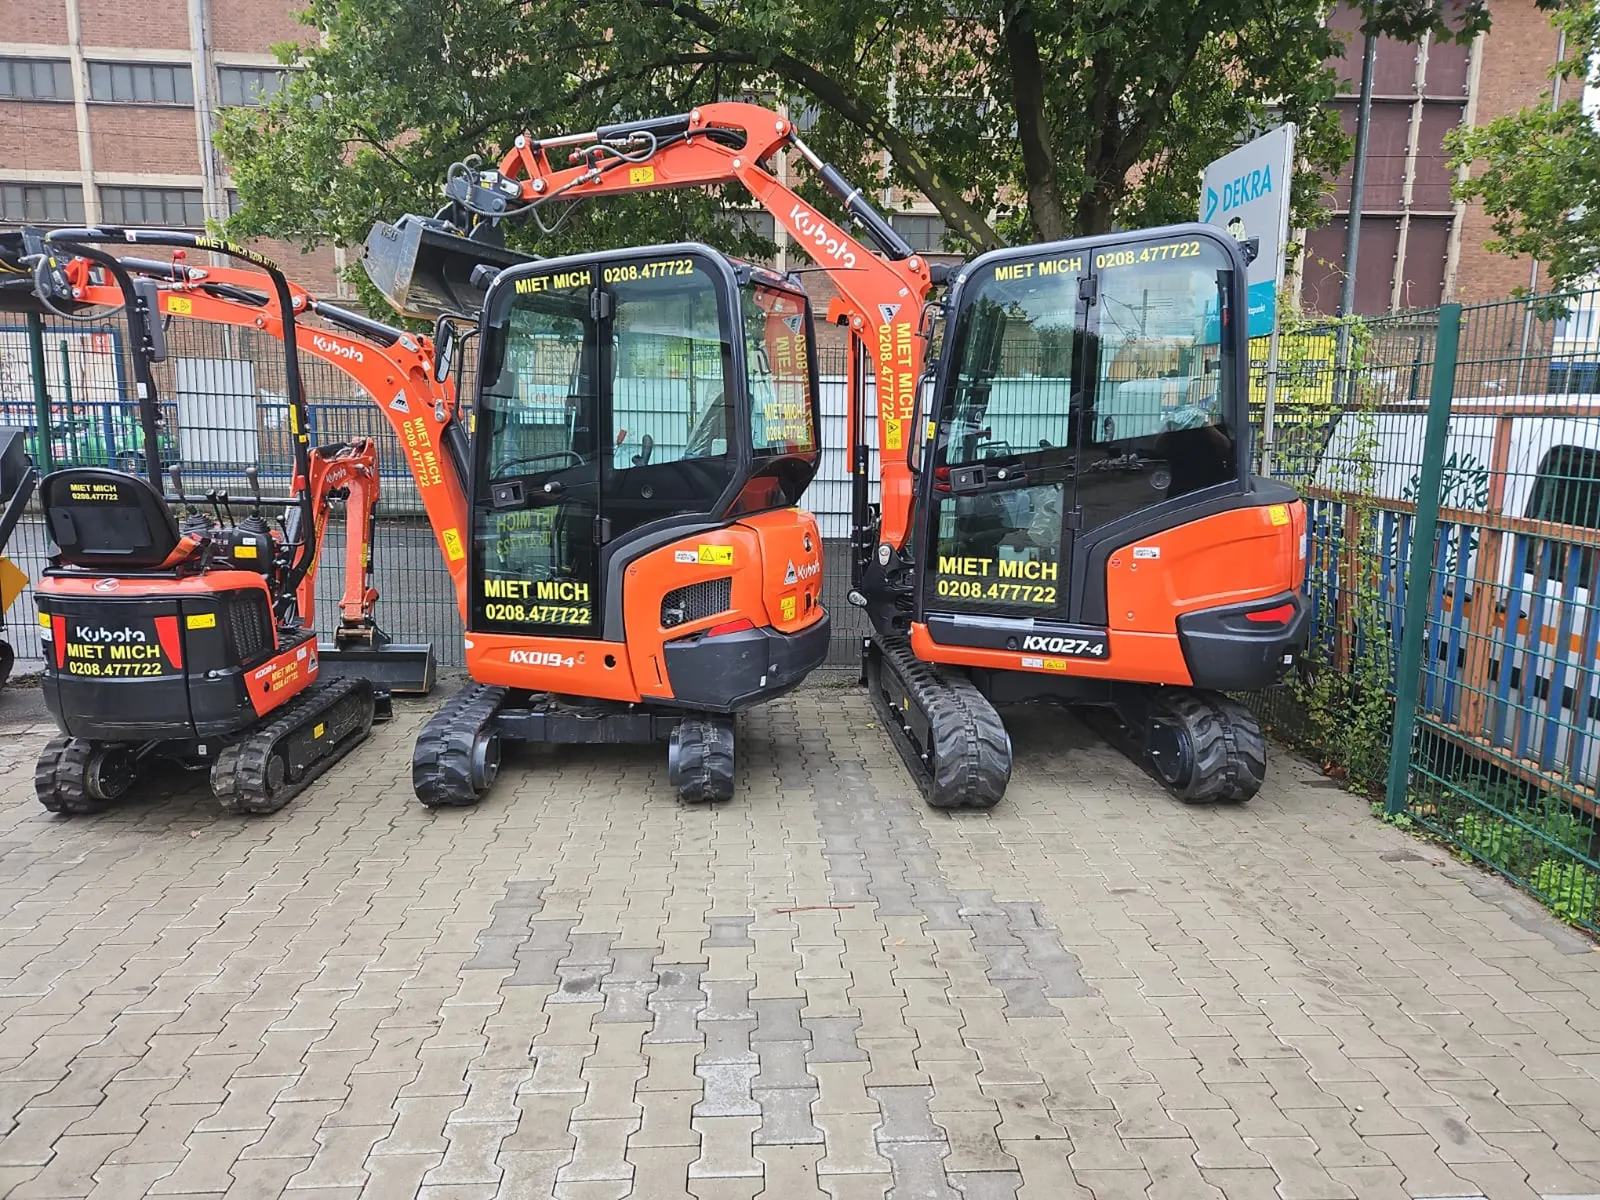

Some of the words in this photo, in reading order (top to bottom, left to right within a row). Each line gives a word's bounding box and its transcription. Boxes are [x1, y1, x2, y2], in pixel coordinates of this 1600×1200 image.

[1223, 164, 1272, 212] DEKRA
[195, 235, 224, 249] MIET
[227, 242, 248, 257] MICH
[789, 204, 856, 268] Kubota
[995, 262, 1034, 281] MIET
[1038, 257, 1081, 276] MICH
[1096, 241, 1200, 269] 0208.477722
[515, 276, 549, 294] MIET
[553, 271, 591, 290] MICH
[603, 259, 693, 283] 0208.477722
[313, 335, 363, 363] Kubota
[896, 322, 912, 367] MIET
[879, 325, 895, 420] 0208.477722
[899, 373, 914, 420] MICH
[403, 421, 430, 487] 0208.477722
[414, 417, 431, 448] MIET
[424, 451, 442, 485] MICH
[939, 556, 992, 576] MIET
[999, 559, 1058, 580] MICH
[484, 580, 531, 599] MIET
[536, 582, 589, 601] MICH
[938, 580, 1056, 603] 0208.477722
[485, 603, 590, 624] 0208.477722
[76, 626, 145, 642] Kubota
[1023, 636, 1103, 655] KX027-4
[67, 643, 104, 659] MIET
[110, 645, 160, 660] MICH
[509, 649, 575, 668] KX019-4
[69, 661, 162, 676] 0208.477722
[271, 667, 285, 681] MIET
